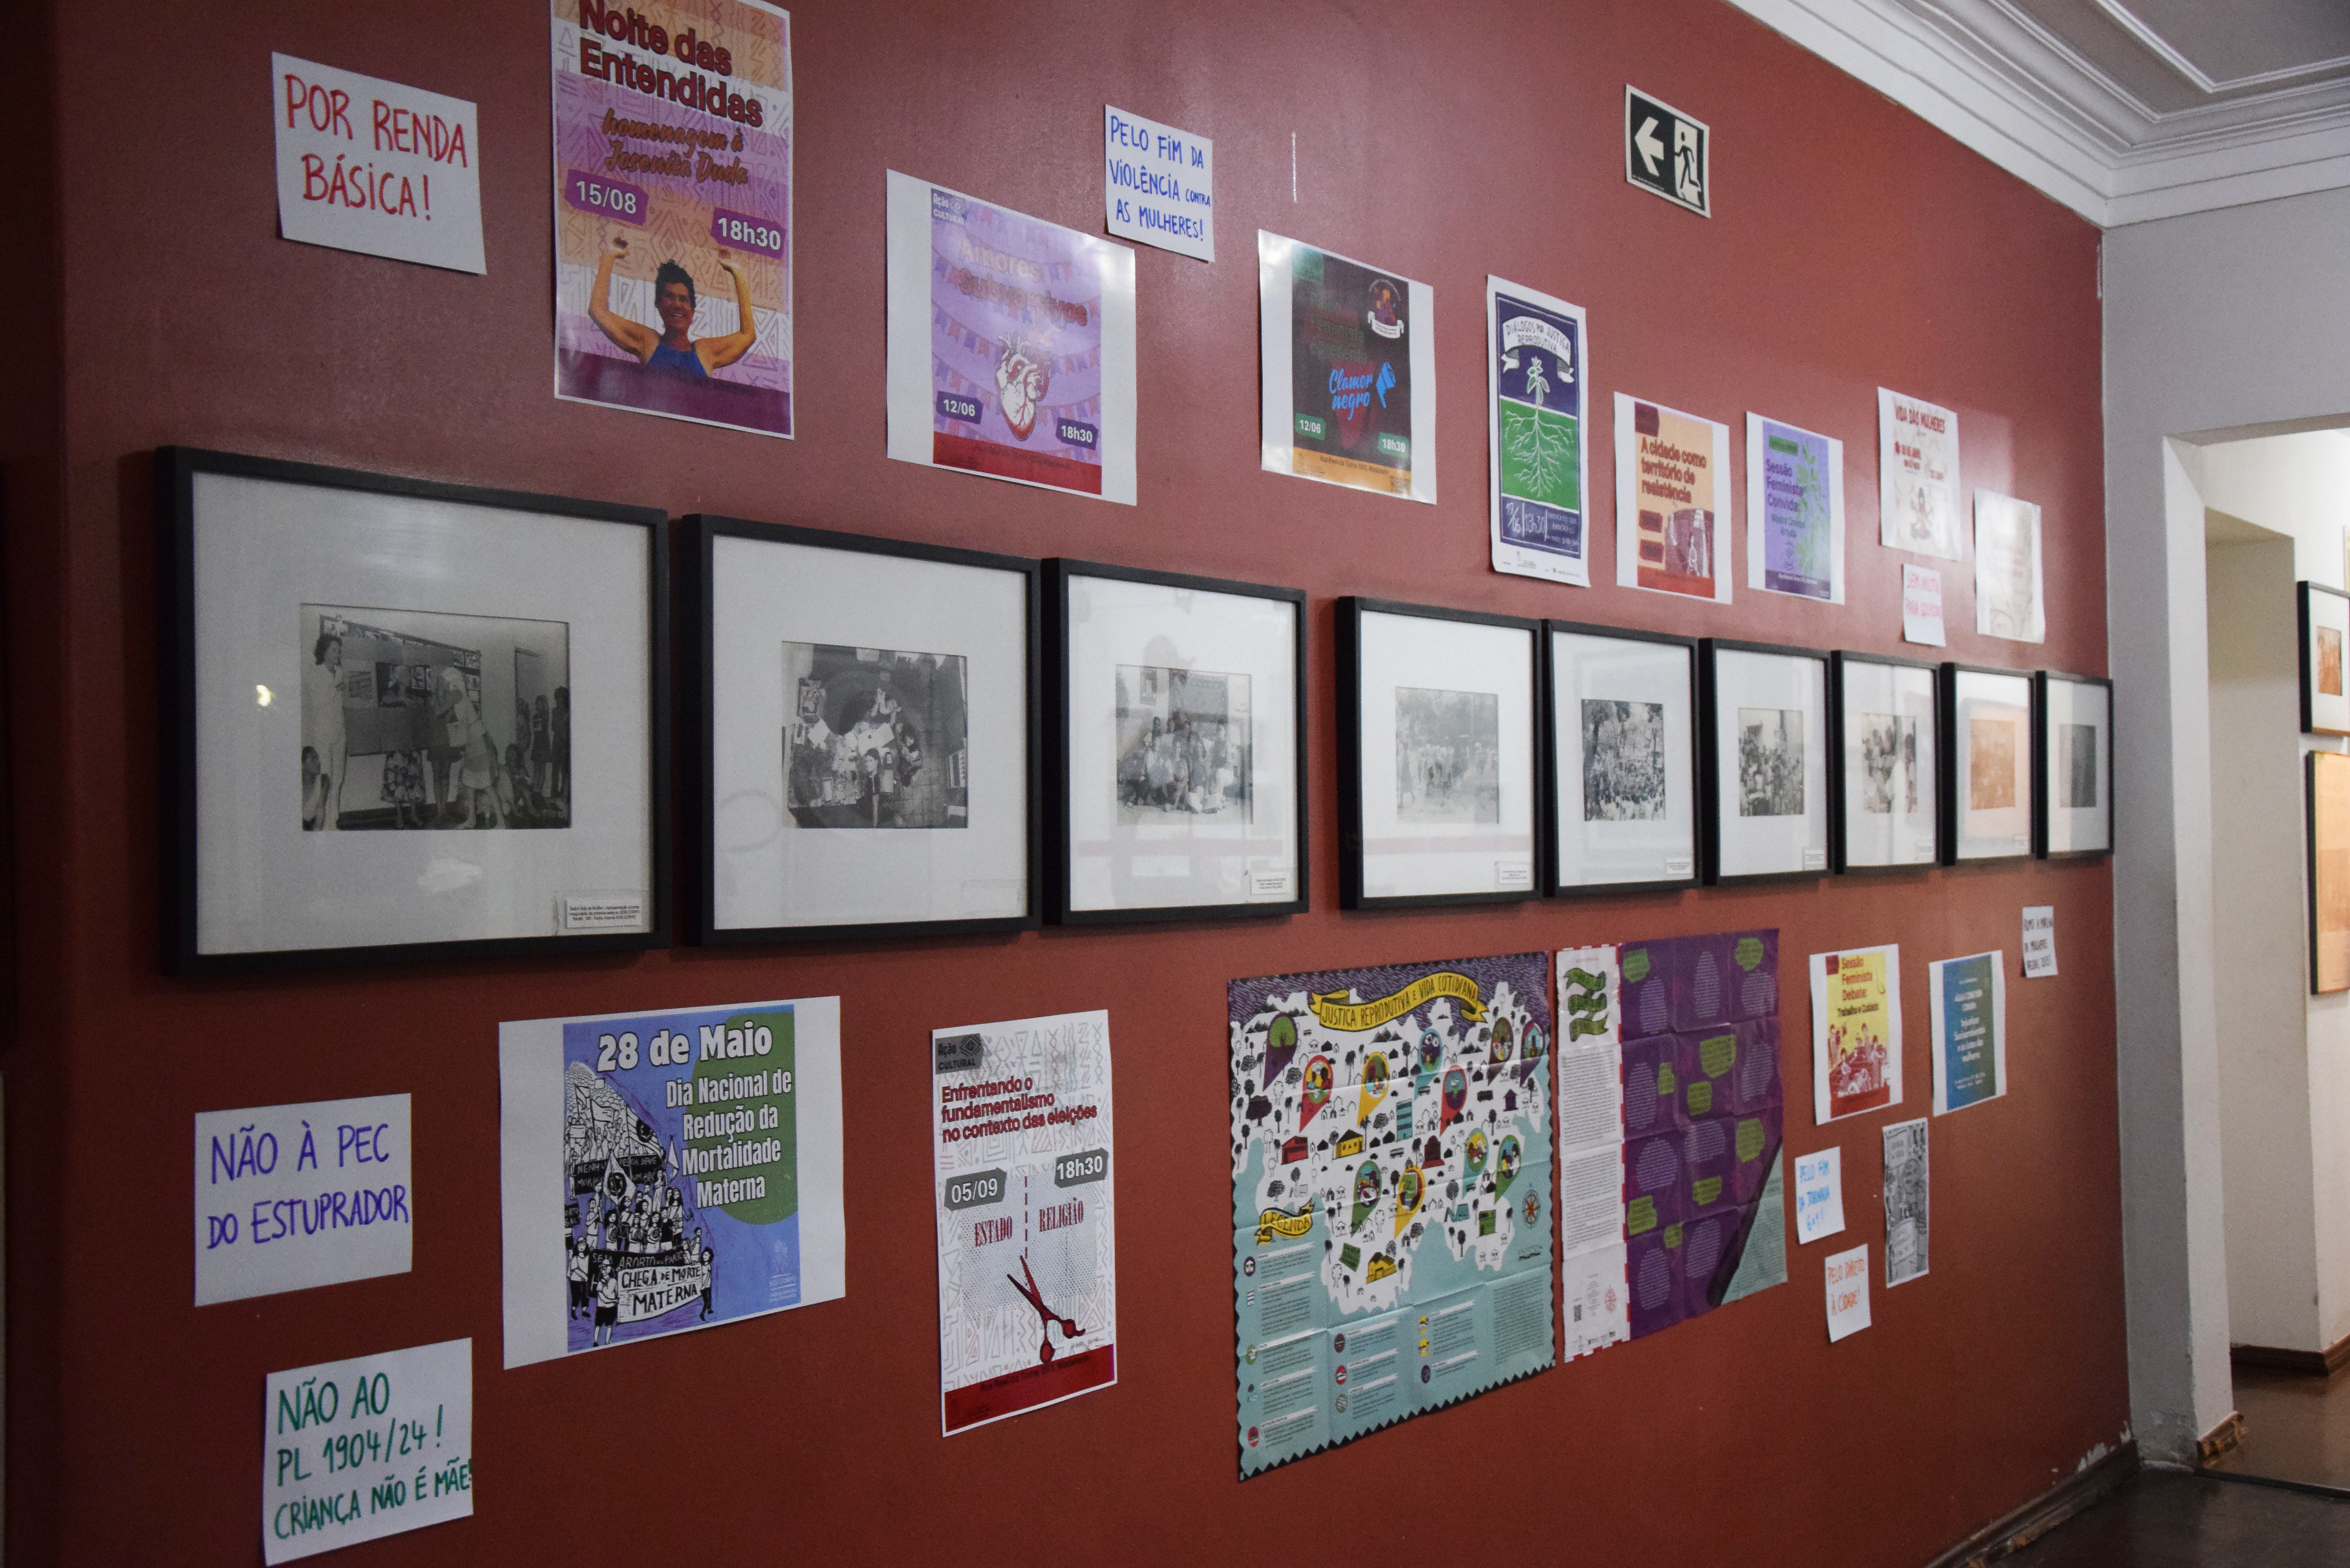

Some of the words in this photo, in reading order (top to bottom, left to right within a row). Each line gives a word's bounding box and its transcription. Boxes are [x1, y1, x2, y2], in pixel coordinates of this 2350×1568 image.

[580, 0, 669, 55] Noite
[674, 28, 732, 76] das
[580, 36, 763, 128] Entendidas
[285, 74, 353, 140] POR
[373, 99, 468, 168] RENDA
[1110, 115, 1149, 152] PELO
[1157, 135, 1183, 165] FIM
[1191, 146, 1204, 169] DA
[301, 153, 431, 221] BÁSICA!
[575, 180, 637, 215] 15/08
[1109, 158, 1180, 202] VIOLÊNCIA
[1185, 188, 1211, 207] CONTRA
[718, 217, 781, 251] 18h30
[1116, 199, 1131, 223] AS
[1138, 205, 1203, 241] MULHERES!
[1328, 368, 1374, 394] Clamor
[943, 399, 976, 417] 12/06
[1331, 391, 1370, 420] negro
[1061, 424, 1093, 443] 18h30
[1299, 419, 1321, 434] 12/06
[1382, 438, 1406, 453] 18h30
[1360, 992, 1411, 1027] REPRODUTIVA
[1419, 978, 1435, 999] VIDA
[596, 1031, 639, 1073] 28
[649, 1028, 690, 1067] de
[699, 1020, 774, 1062] Maio
[938, 1058, 976, 1071] CULTURAL
[666, 1078, 694, 1109] Dia
[698, 1070, 768, 1104] Nacional
[772, 1068, 793, 1096] de
[941, 1075, 1022, 1103] Enfrentando
[1024, 1077, 1033, 1089] o
[941, 1092, 1055, 1123] fundamentalismo
[683, 1104, 755, 1144] Redução
[759, 1103, 779, 1130] da
[942, 1127, 961, 1144] no
[962, 1116, 1020, 1140] contexto
[1022, 1111, 1046, 1130] das
[1047, 1104, 1098, 1125] eleições
[212, 1123, 279, 1184] NÃO
[297, 1120, 318, 1172] À
[337, 1123, 390, 1168] PEC
[682, 1136, 782, 1177] Mortalidade
[1056, 1155, 1103, 1181] 18h30
[696, 1175, 766, 1208] Materna
[951, 1178, 998, 1204] 05/09
[207, 1212, 239, 1250] DO
[251, 1184, 410, 1244] ESTUPRADOR
[974, 1215, 1013, 1247] ESTADO
[621, 1269, 658, 1289] CHEGA
[661, 1271, 670, 1281] DE
[672, 1266, 701, 1283] MORTE
[633, 1283, 698, 1316] MATERNA
[278, 1376, 339, 1435] NÃO
[350, 1371, 390, 1420] AO
[277, 1447, 313, 1487] PL
[274, 1489, 362, 1540] CRIANÇA
[371, 1473, 407, 1515] NÃO
[414, 1465, 428, 1501] É
